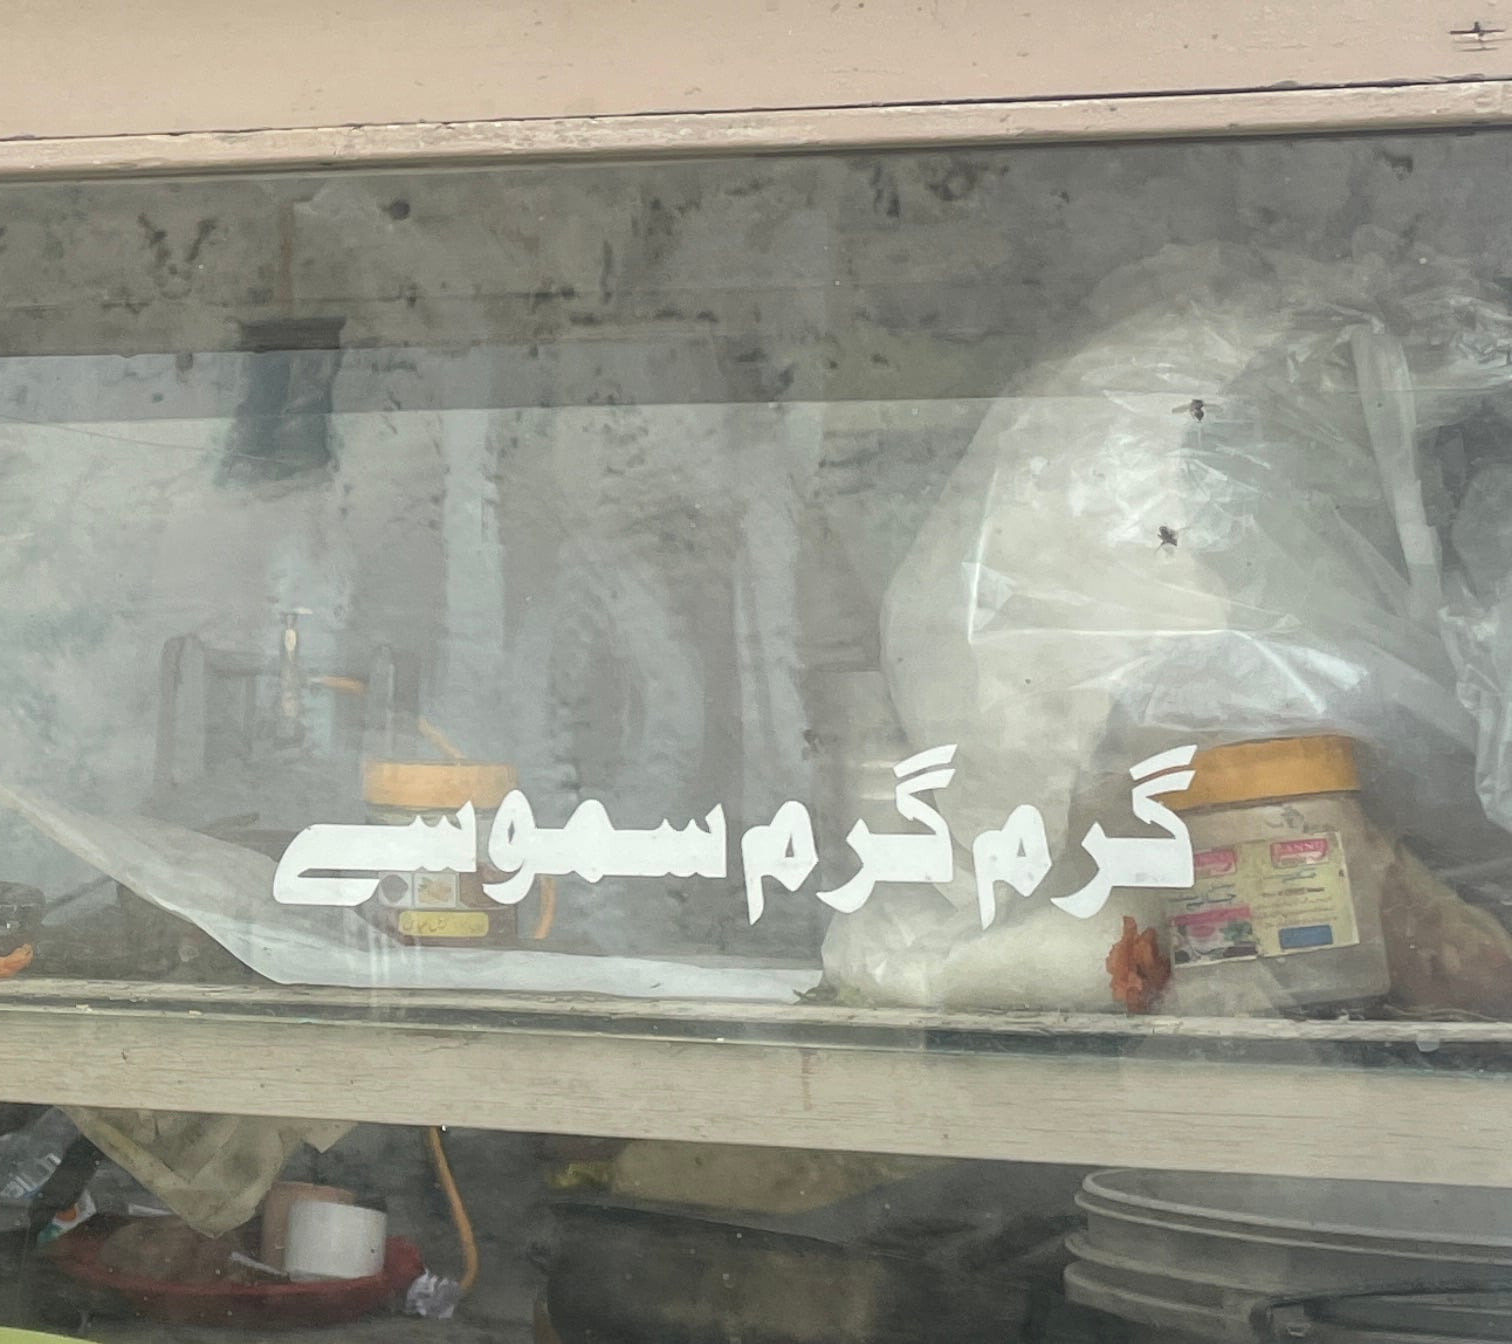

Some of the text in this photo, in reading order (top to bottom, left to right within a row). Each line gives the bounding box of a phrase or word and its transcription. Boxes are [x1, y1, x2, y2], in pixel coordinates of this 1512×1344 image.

[272, 743, 1198, 932] گرم گرم سموسے
